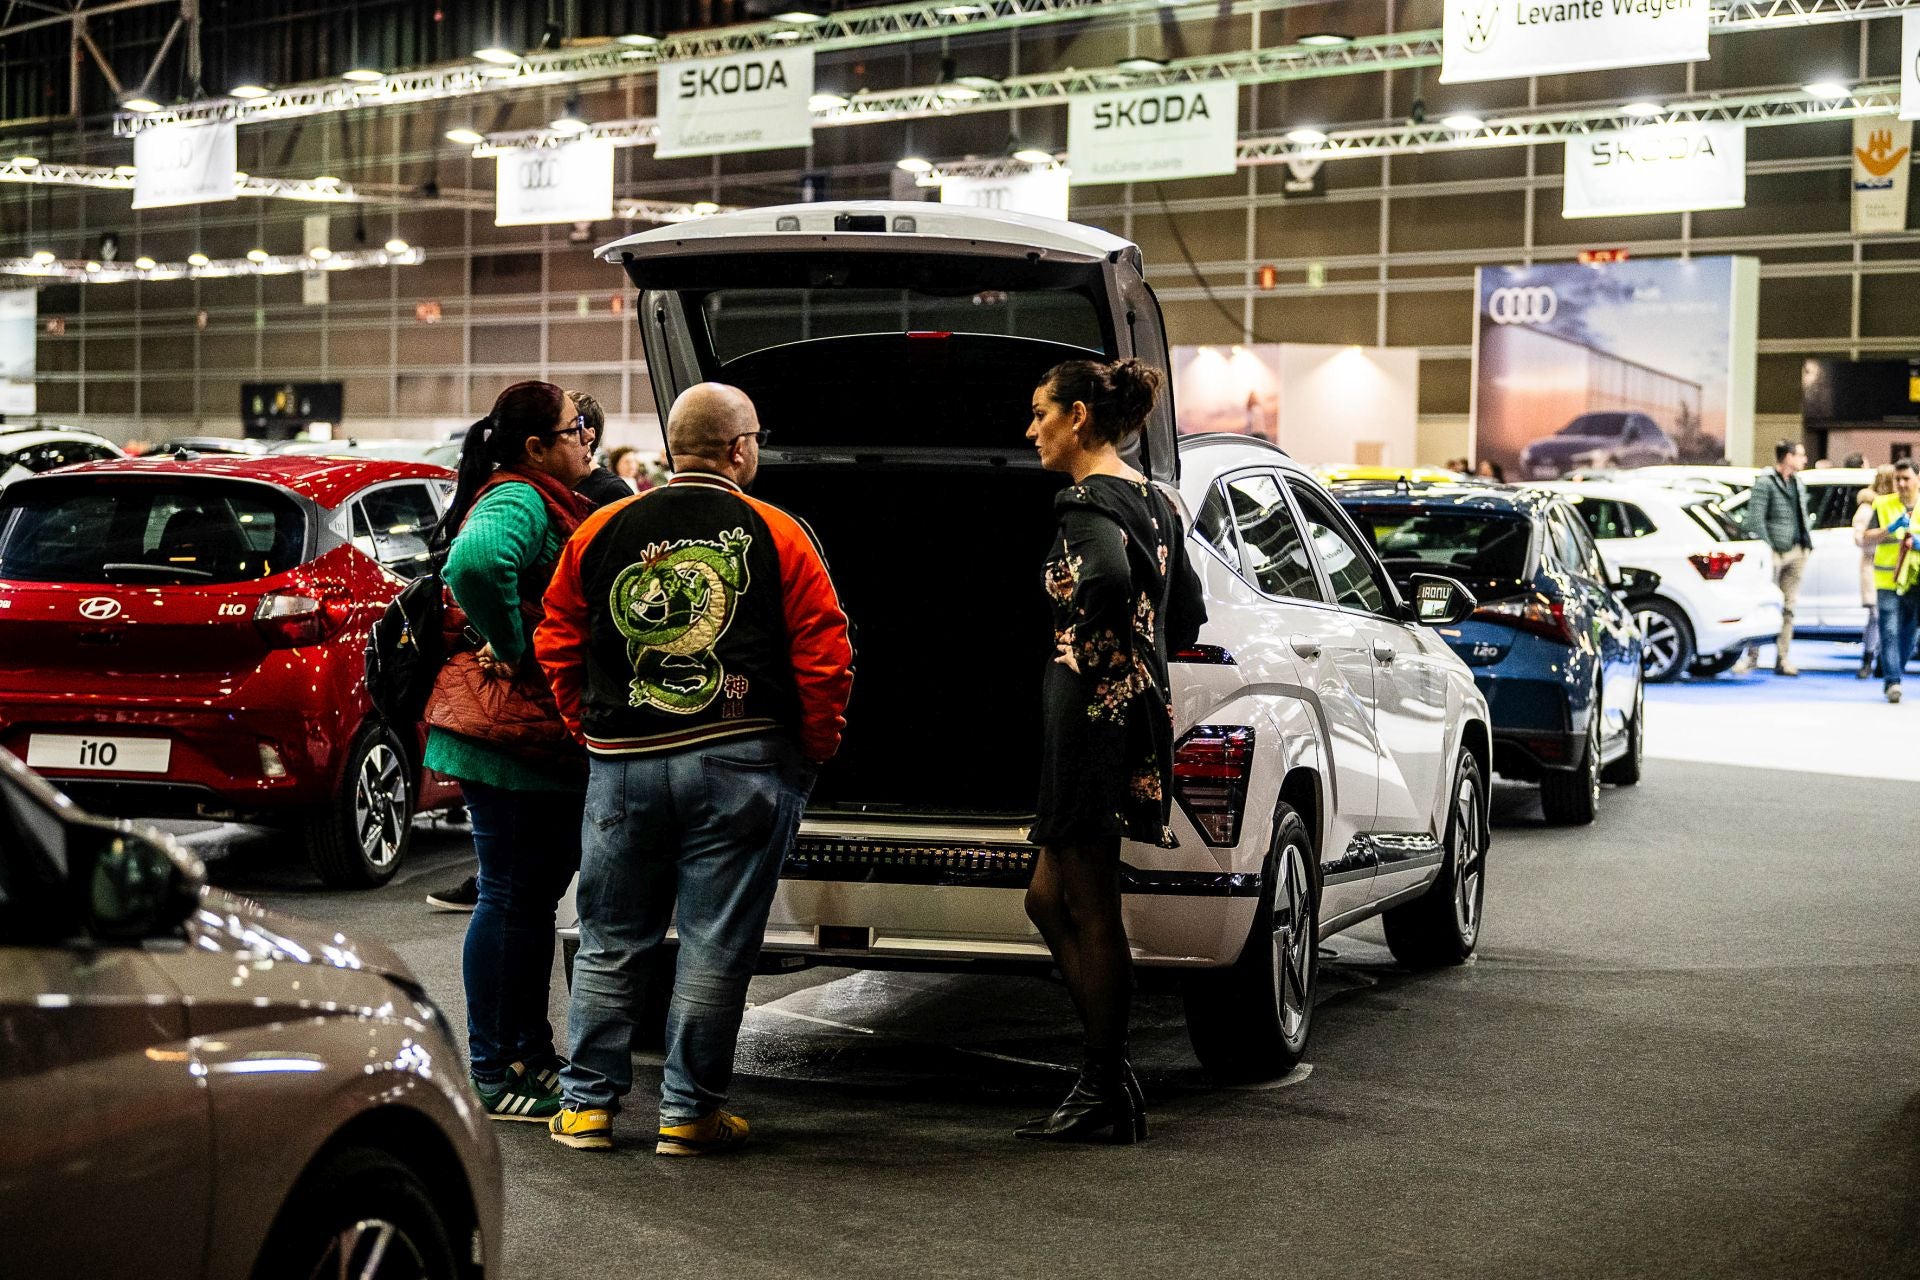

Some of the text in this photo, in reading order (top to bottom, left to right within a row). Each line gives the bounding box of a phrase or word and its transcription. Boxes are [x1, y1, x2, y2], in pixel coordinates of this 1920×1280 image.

[1517, 0, 1691, 25] Levante Wagen
[218, 603, 247, 616] i10
[79, 740, 117, 766] i10
